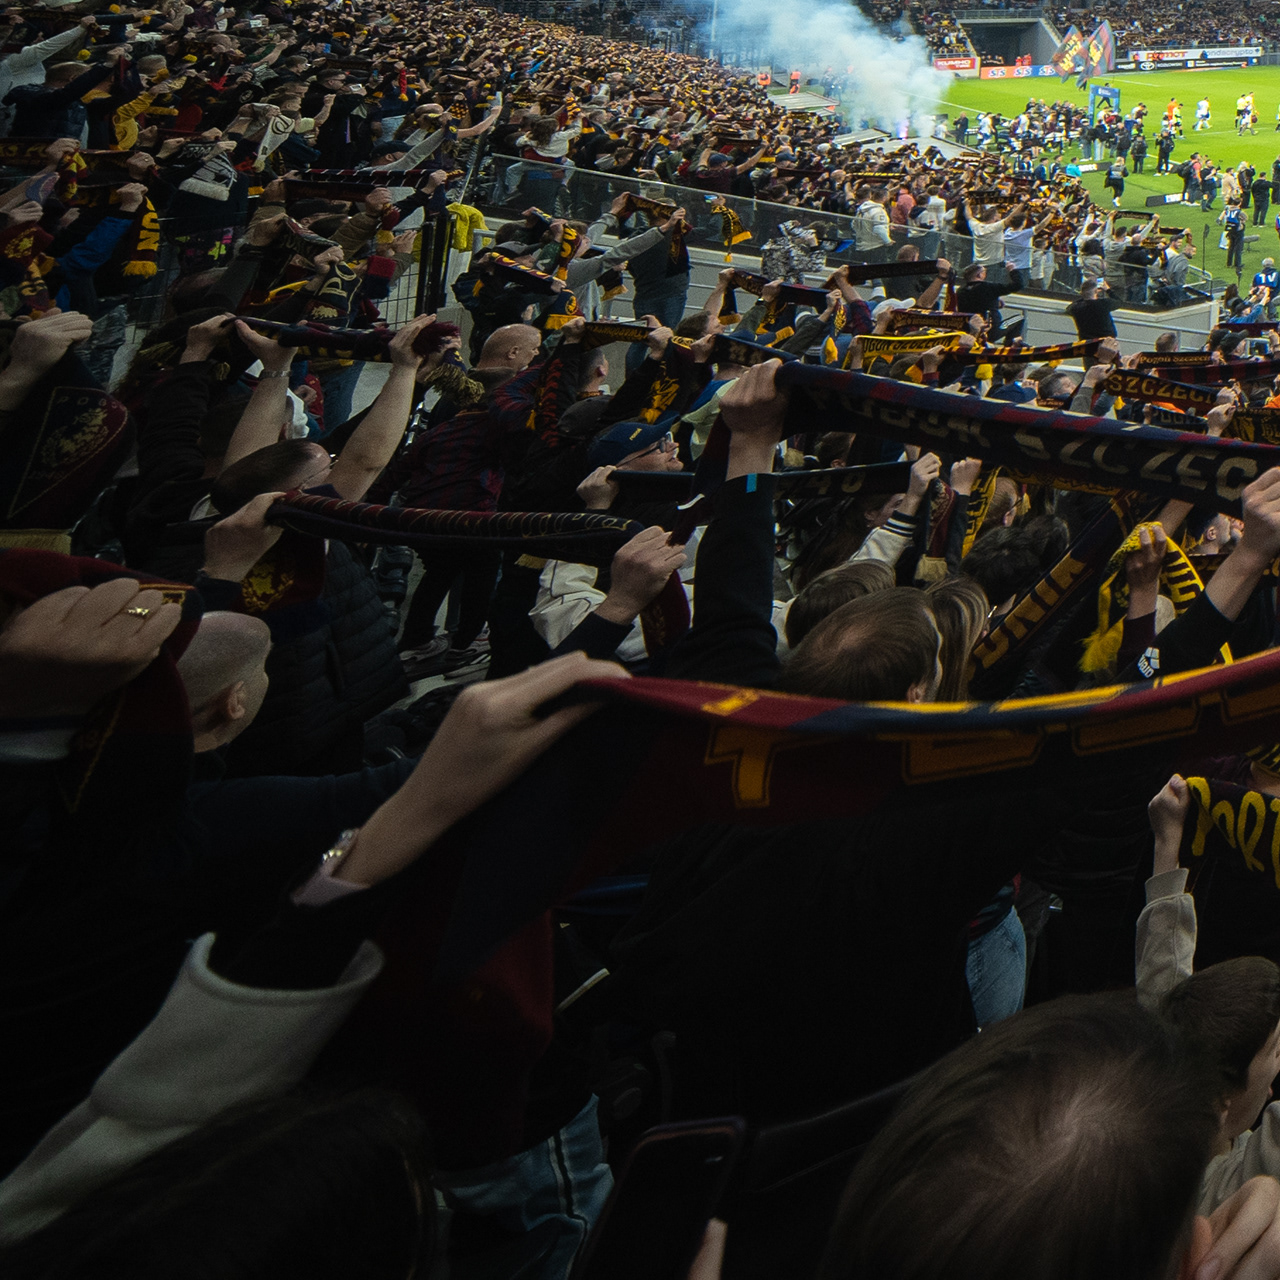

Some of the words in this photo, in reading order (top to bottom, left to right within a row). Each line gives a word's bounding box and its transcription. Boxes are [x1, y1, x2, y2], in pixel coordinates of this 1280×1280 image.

[1203, 49, 1253, 58] ondacrypto
[988, 69, 1006, 77] STS
[1014, 67, 1032, 76] STS
[1260, 272, 1277, 284] TV
